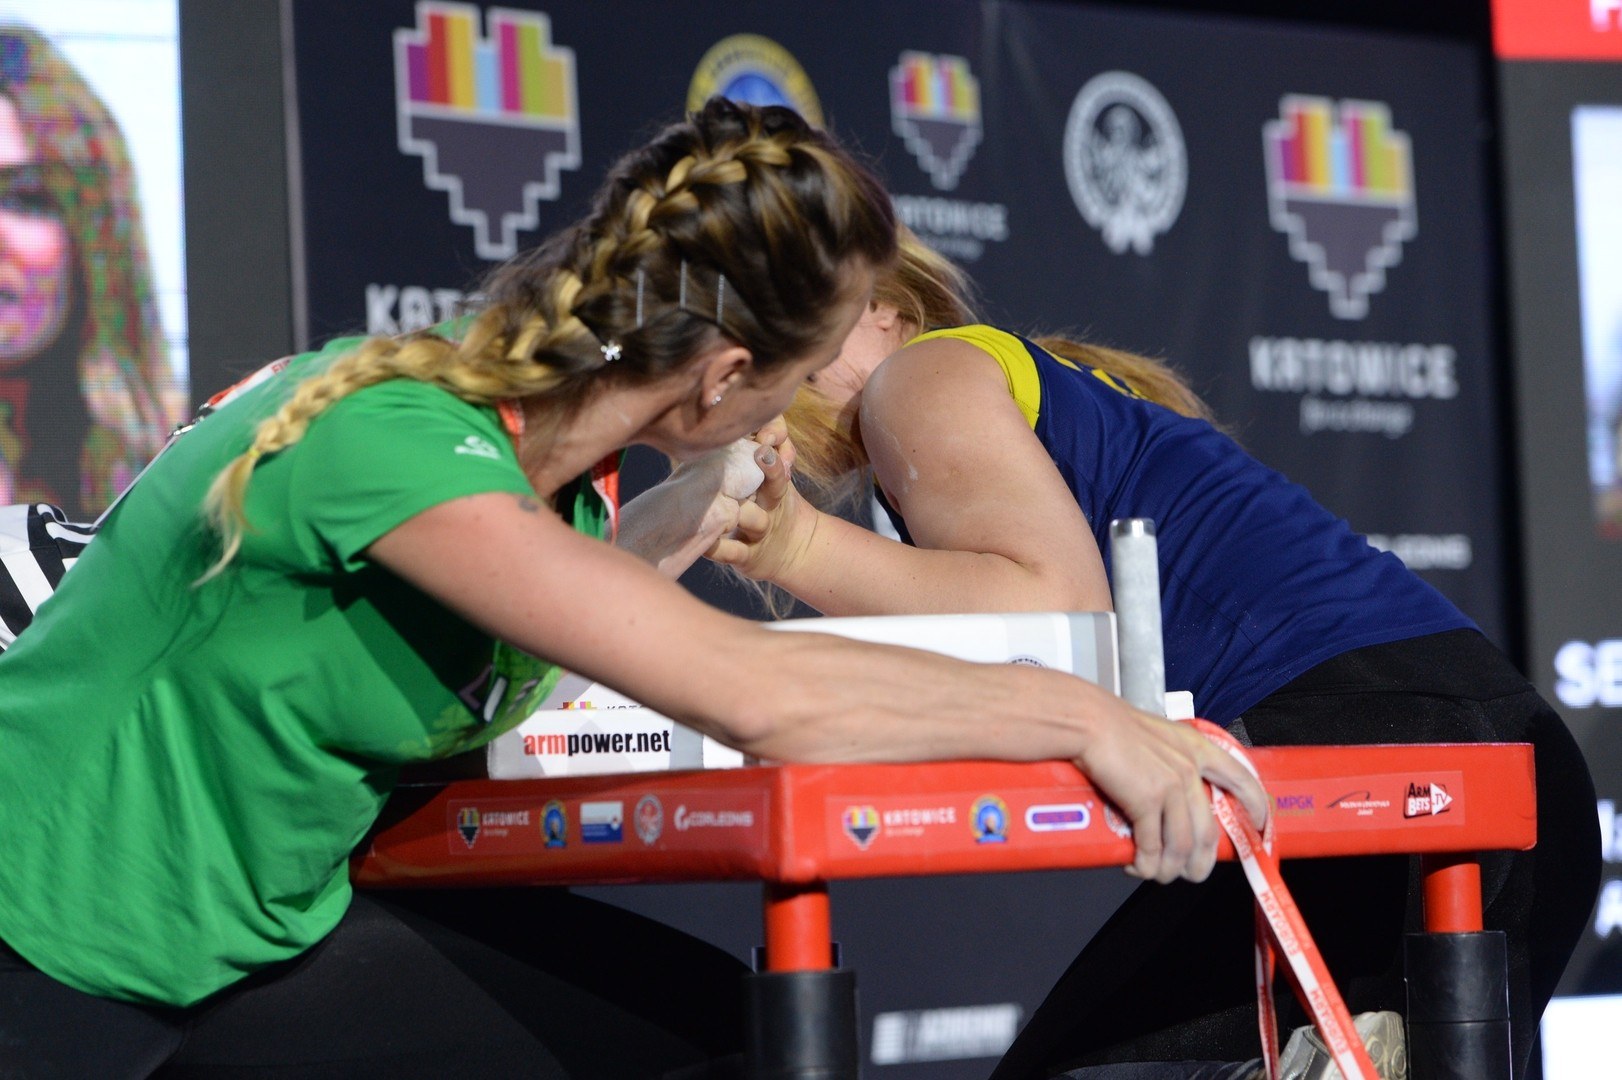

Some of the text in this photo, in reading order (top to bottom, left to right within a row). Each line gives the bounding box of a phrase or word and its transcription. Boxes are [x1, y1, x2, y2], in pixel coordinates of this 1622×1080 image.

[1249, 335, 1459, 399] KATOWICE
[523, 730, 671, 757] armpower.net
[1277, 795, 1313, 811] MPGK
[482, 811, 530, 827] KATOWICE
[882, 807, 956, 826] KATOWICE
